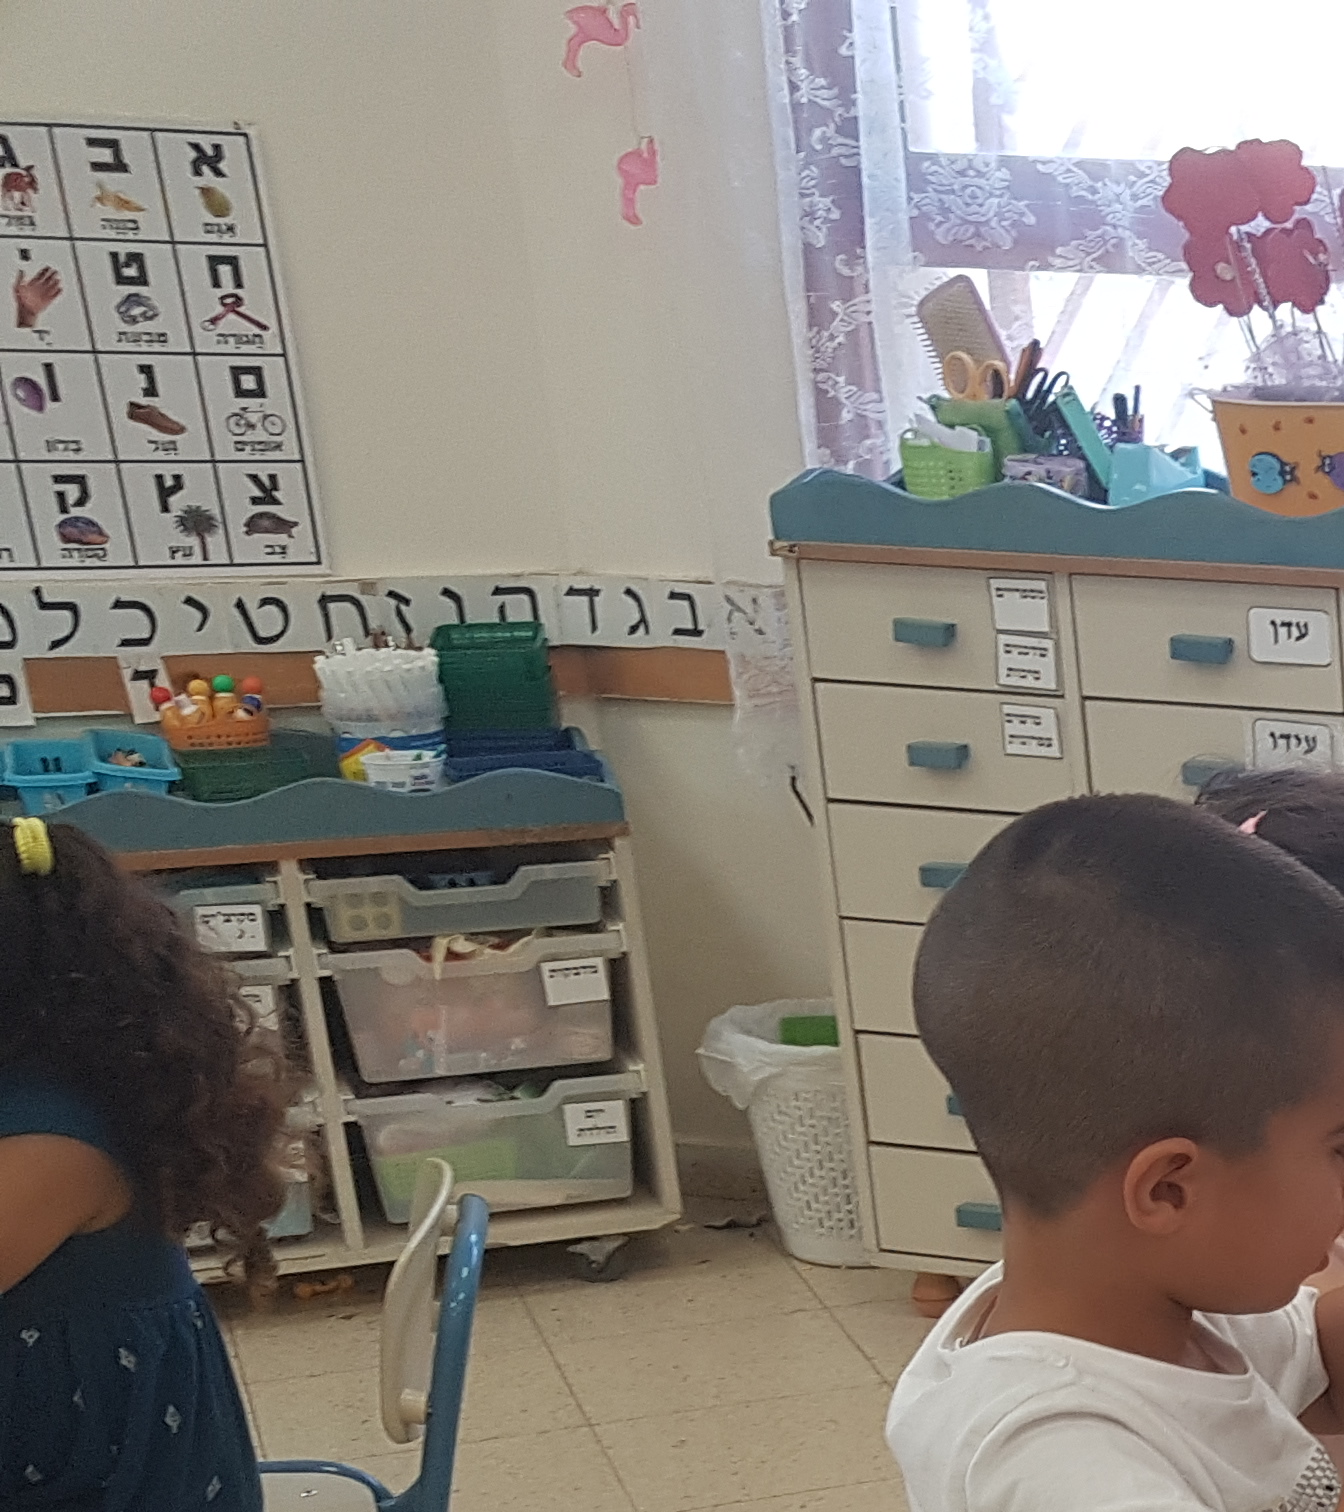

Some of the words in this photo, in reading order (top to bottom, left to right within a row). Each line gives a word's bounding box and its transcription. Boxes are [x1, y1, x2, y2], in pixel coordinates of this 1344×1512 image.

[85, 137, 131, 173] ב
[187, 141, 227, 177] א
[205, 255, 243, 289] ח
[51, 474, 91, 514] ק
[245, 473, 283, 505] צ
[1269, 619, 1309, 645] עדן
[1269, 731, 1318, 755] עידו
